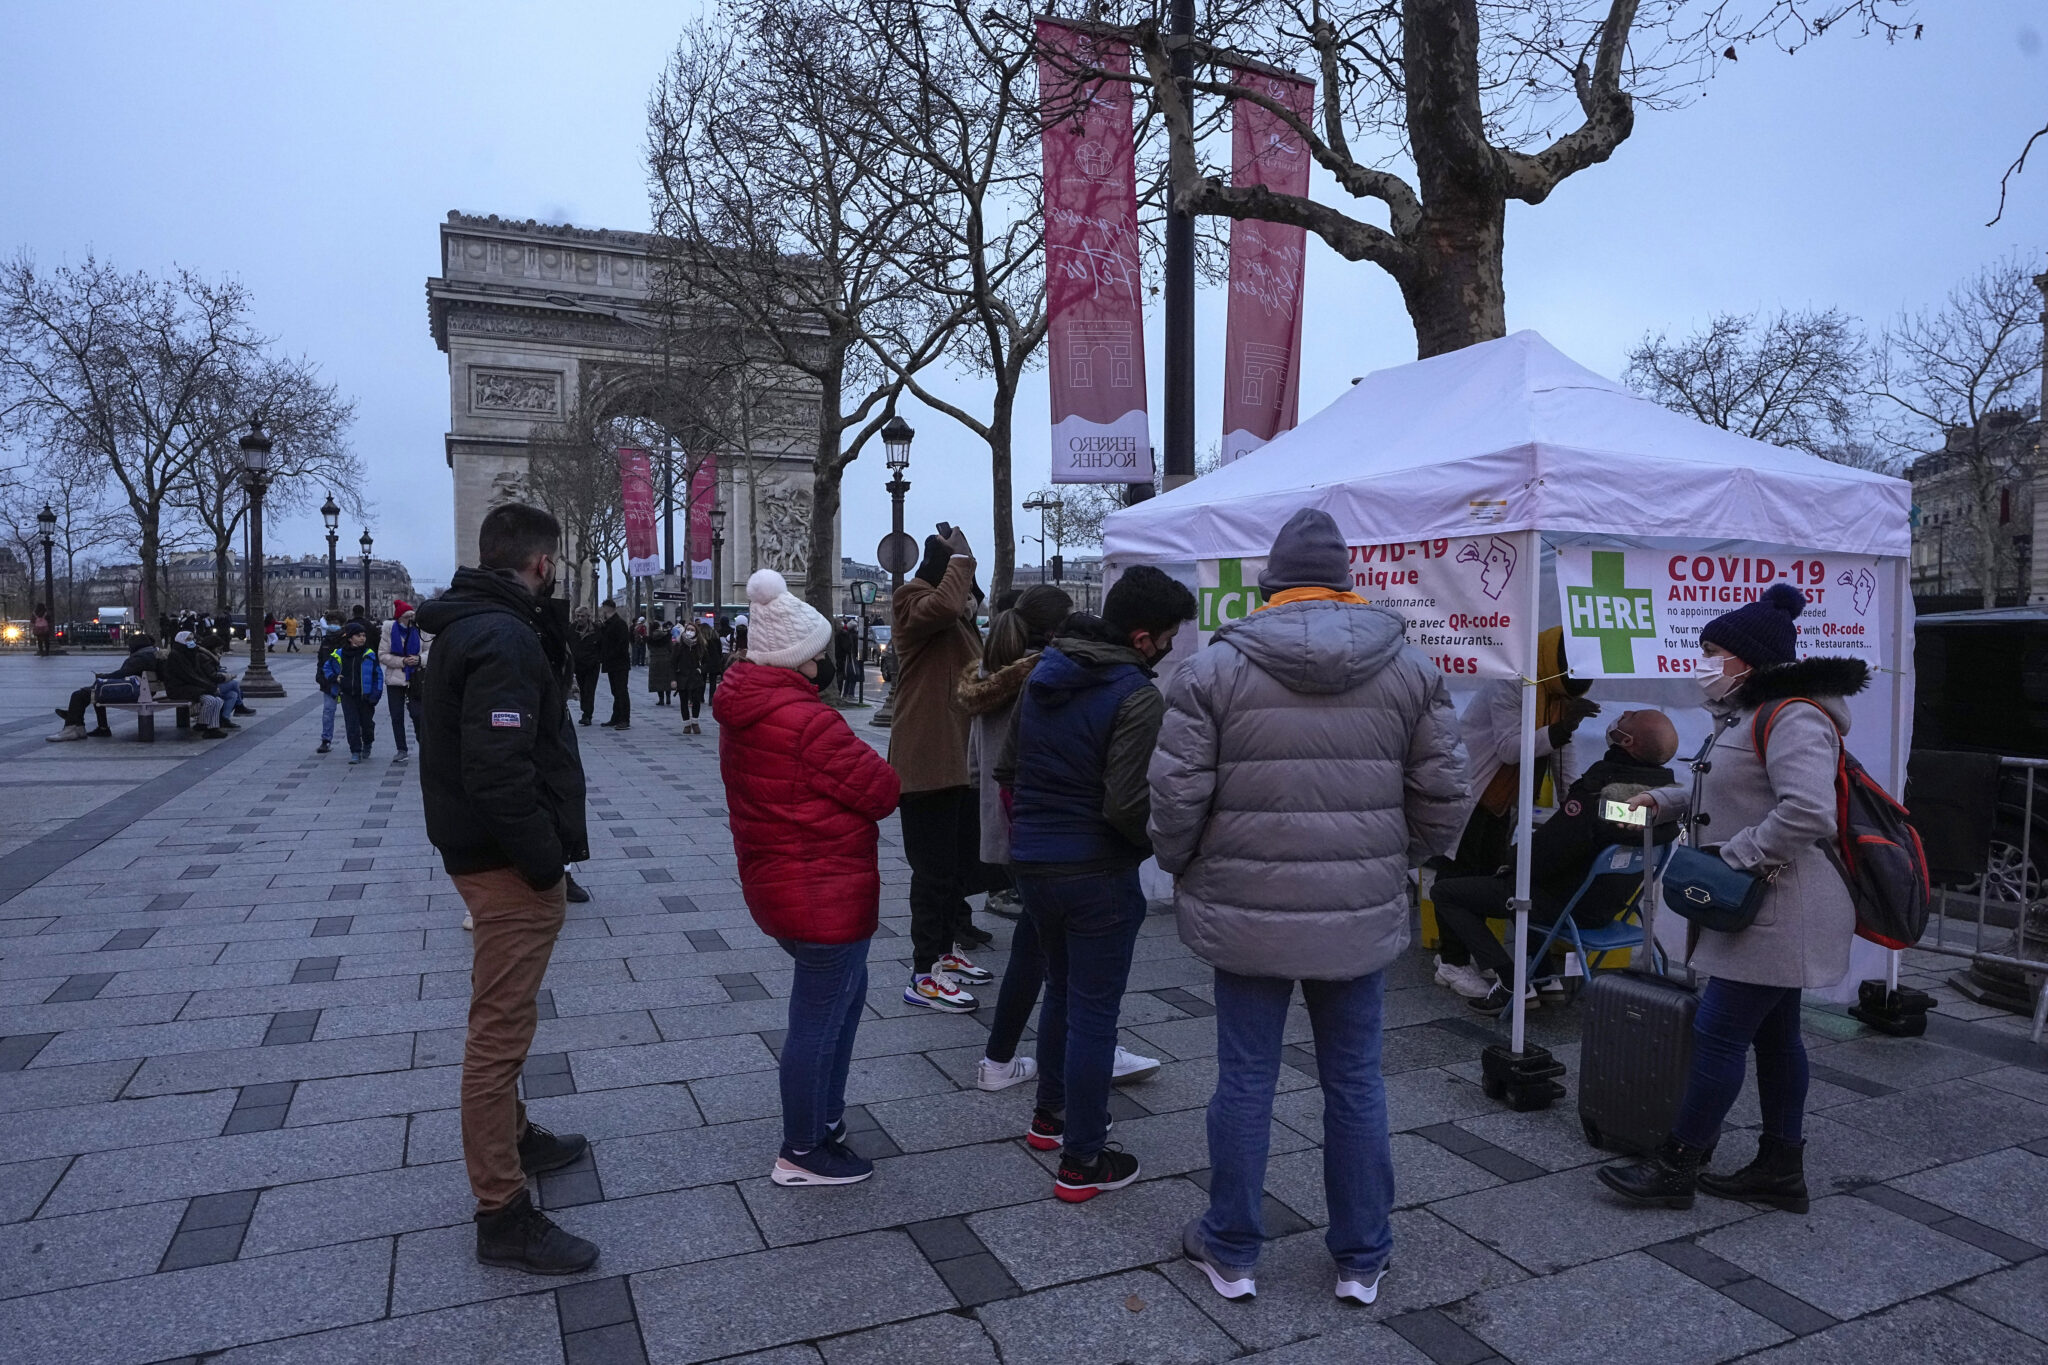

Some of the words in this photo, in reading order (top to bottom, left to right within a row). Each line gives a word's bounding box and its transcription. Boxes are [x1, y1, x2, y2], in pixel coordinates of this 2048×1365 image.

[1668, 555, 1825, 585] COVID-19
[1204, 591, 1255, 626] ICI
[1571, 595, 1652, 630] HERE
[1667, 608, 1678, 616] no
[1419, 619, 1446, 629] avec
[1448, 612, 1511, 632] QR-code
[1669, 625, 1689, 634] Your
[1803, 625, 1820, 635] with
[1822, 622, 1865, 637] QR-code
[1420, 634, 1504, 646] Restaurants...
[1664, 638, 1678, 649] for
[1815, 639, 1872, 649] Restaurants...
